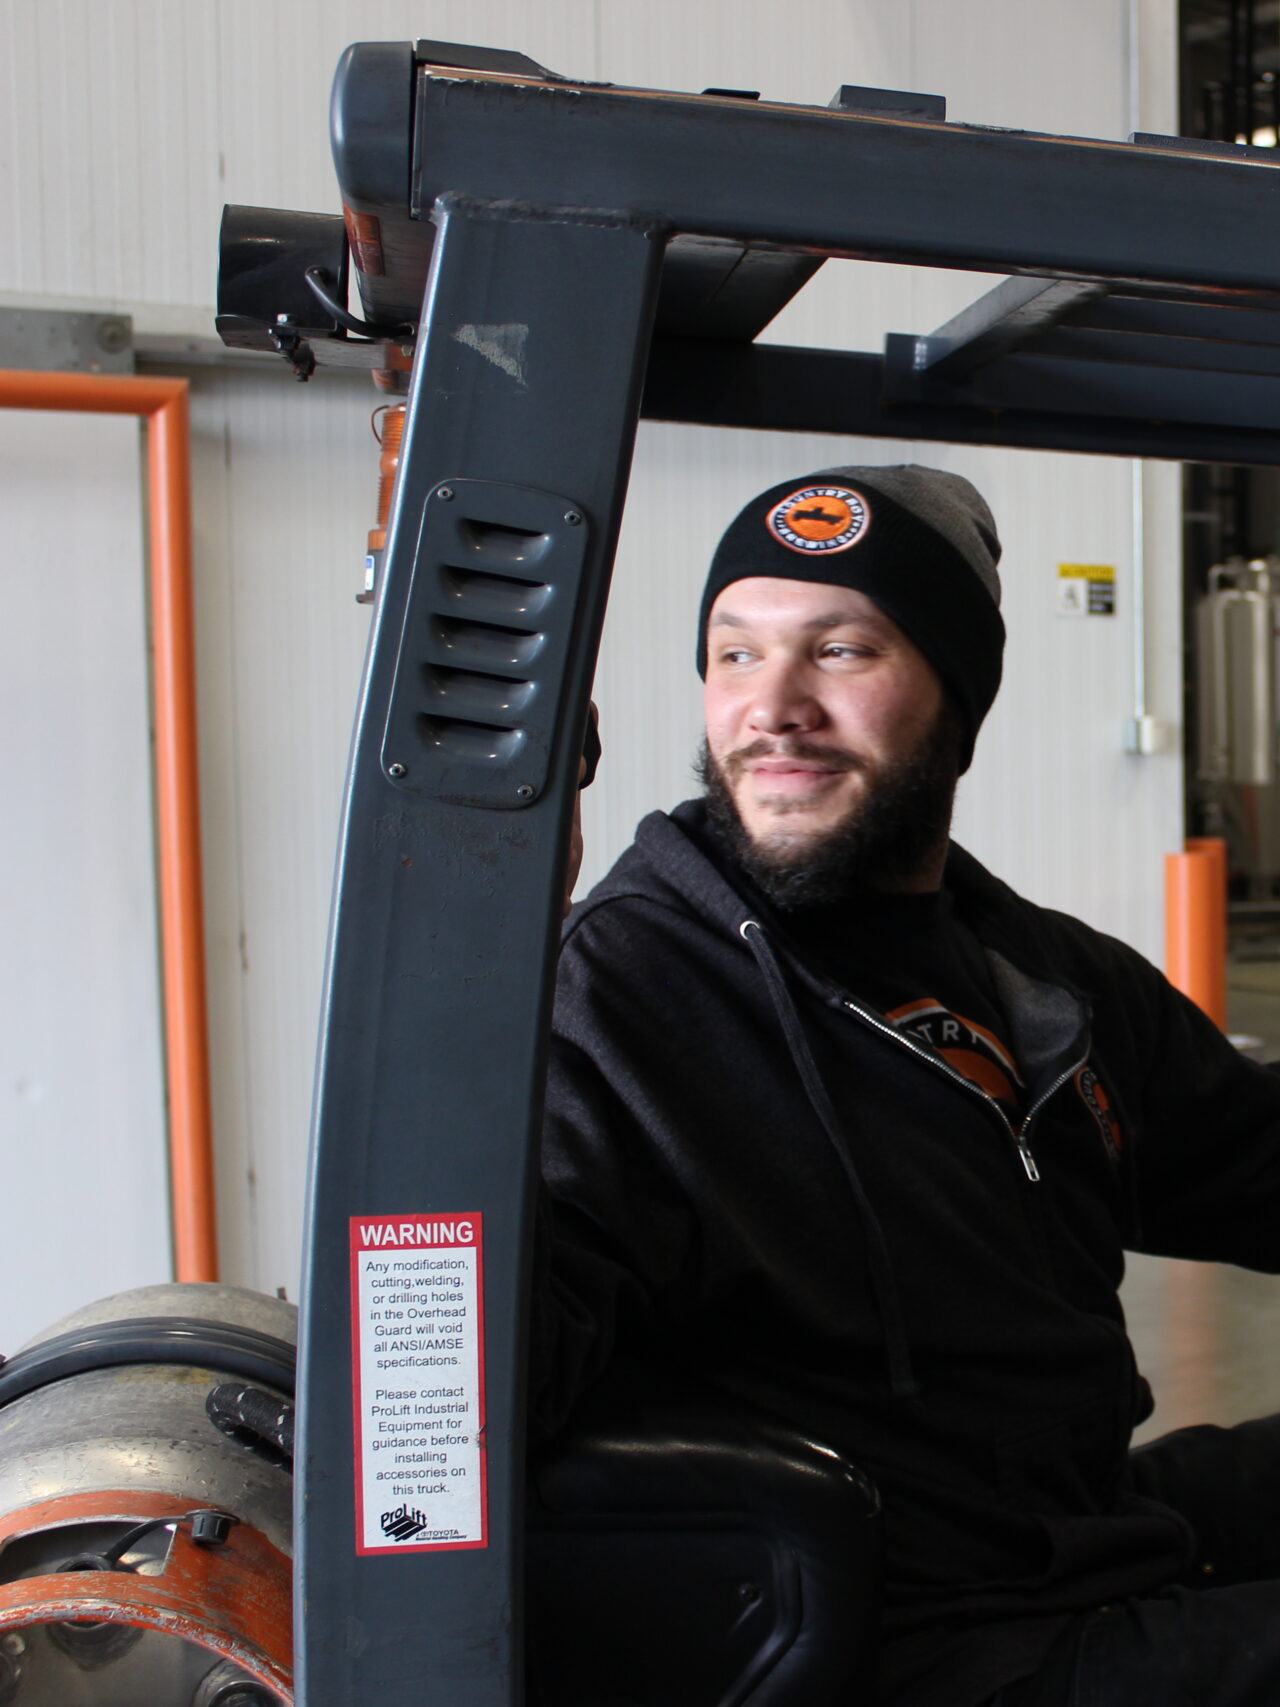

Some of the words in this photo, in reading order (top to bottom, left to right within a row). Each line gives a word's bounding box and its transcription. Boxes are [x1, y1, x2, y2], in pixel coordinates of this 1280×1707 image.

[359, 1221, 474, 1246] WARNING
[366, 1261, 389, 1274] Any
[393, 1259, 469, 1271] modification,
[372, 1295, 385, 1304] or
[388, 1293, 428, 1305] drilling
[431, 1291, 464, 1302] holes
[370, 1310, 381, 1320] in
[384, 1309, 403, 1320] the
[407, 1307, 466, 1319] Overhead
[374, 1325, 412, 1336] Guard
[416, 1323, 434, 1334] will
[438, 1322, 463, 1334] void
[374, 1342, 387, 1352] all
[390, 1338, 464, 1352] ANSI/AMSE
[377, 1356, 461, 1370] specifications.
[376, 1389, 417, 1400] Please
[421, 1387, 464, 1398] contact
[371, 1405, 411, 1417] ProLift
[414, 1402, 469, 1414] Industrial
[378, 1420, 443, 1434] Equipment
[447, 1419, 463, 1429] for
[372, 1438, 427, 1451] guidance
[431, 1435, 469, 1446] before
[395, 1452, 447, 1464] installing
[376, 1468, 448, 1481] accessories
[451, 1467, 466, 1477] on
[393, 1485, 414, 1496] this
[417, 1484, 450, 1495] truck.
[381, 1503, 428, 1528] ProLift
